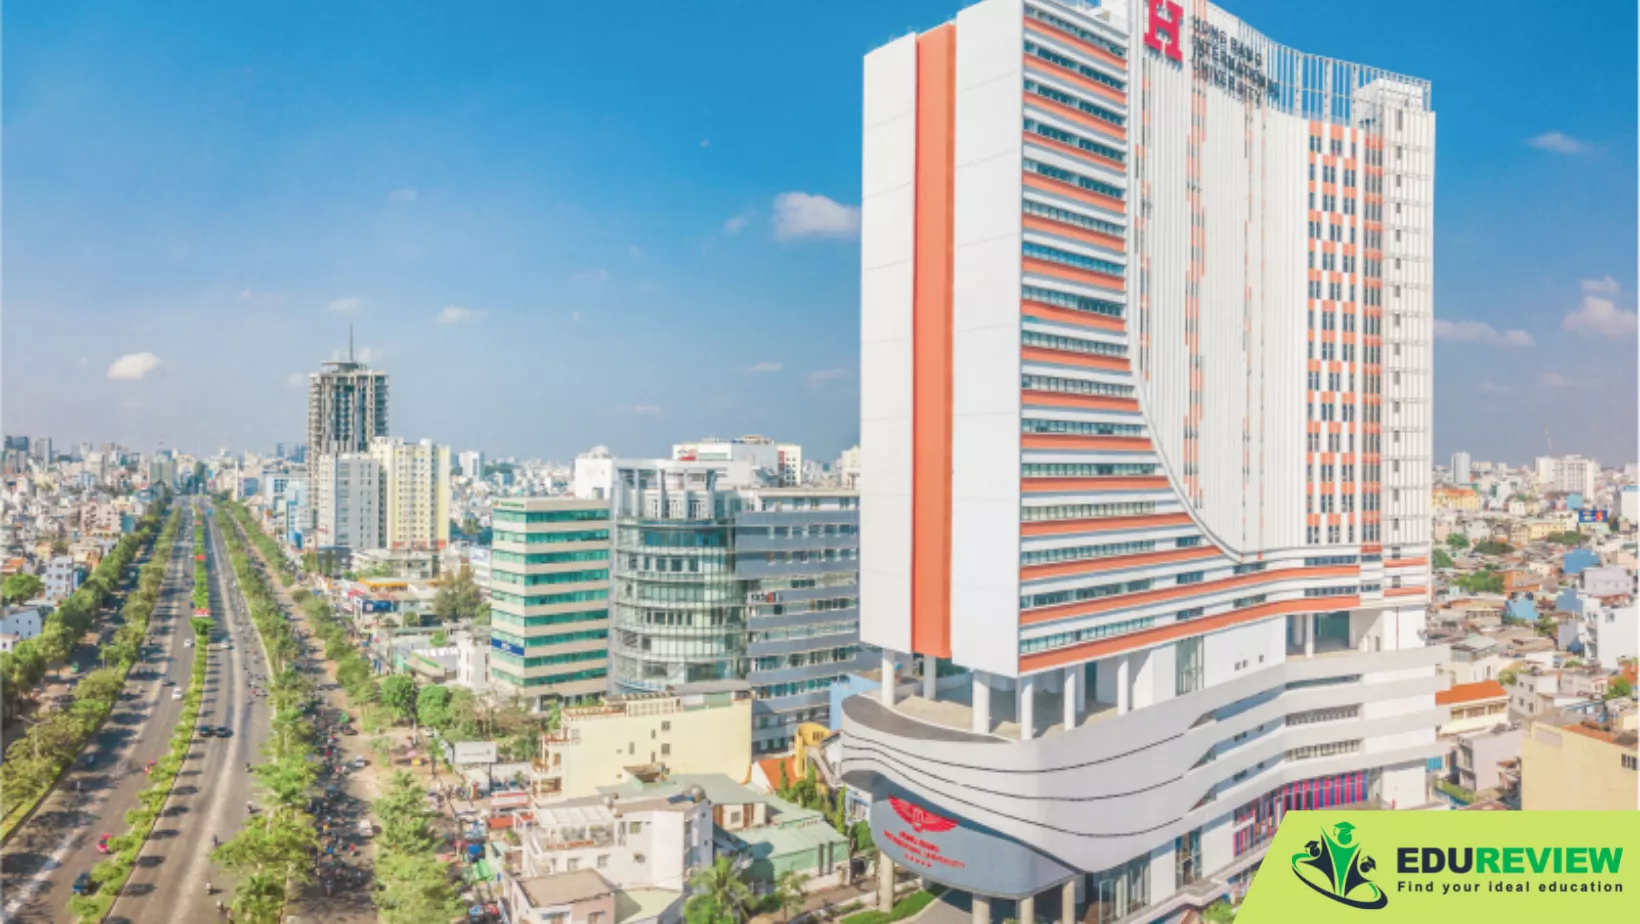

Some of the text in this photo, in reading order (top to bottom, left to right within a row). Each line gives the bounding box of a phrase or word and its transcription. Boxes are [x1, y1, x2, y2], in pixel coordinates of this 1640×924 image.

[1144, 0, 1184, 62] H
[1193, 15, 1262, 66] HONG BANG
[1193, 35, 1280, 99] INTERNATIONAL
[1193, 57, 1261, 104] UNIVERSITY
